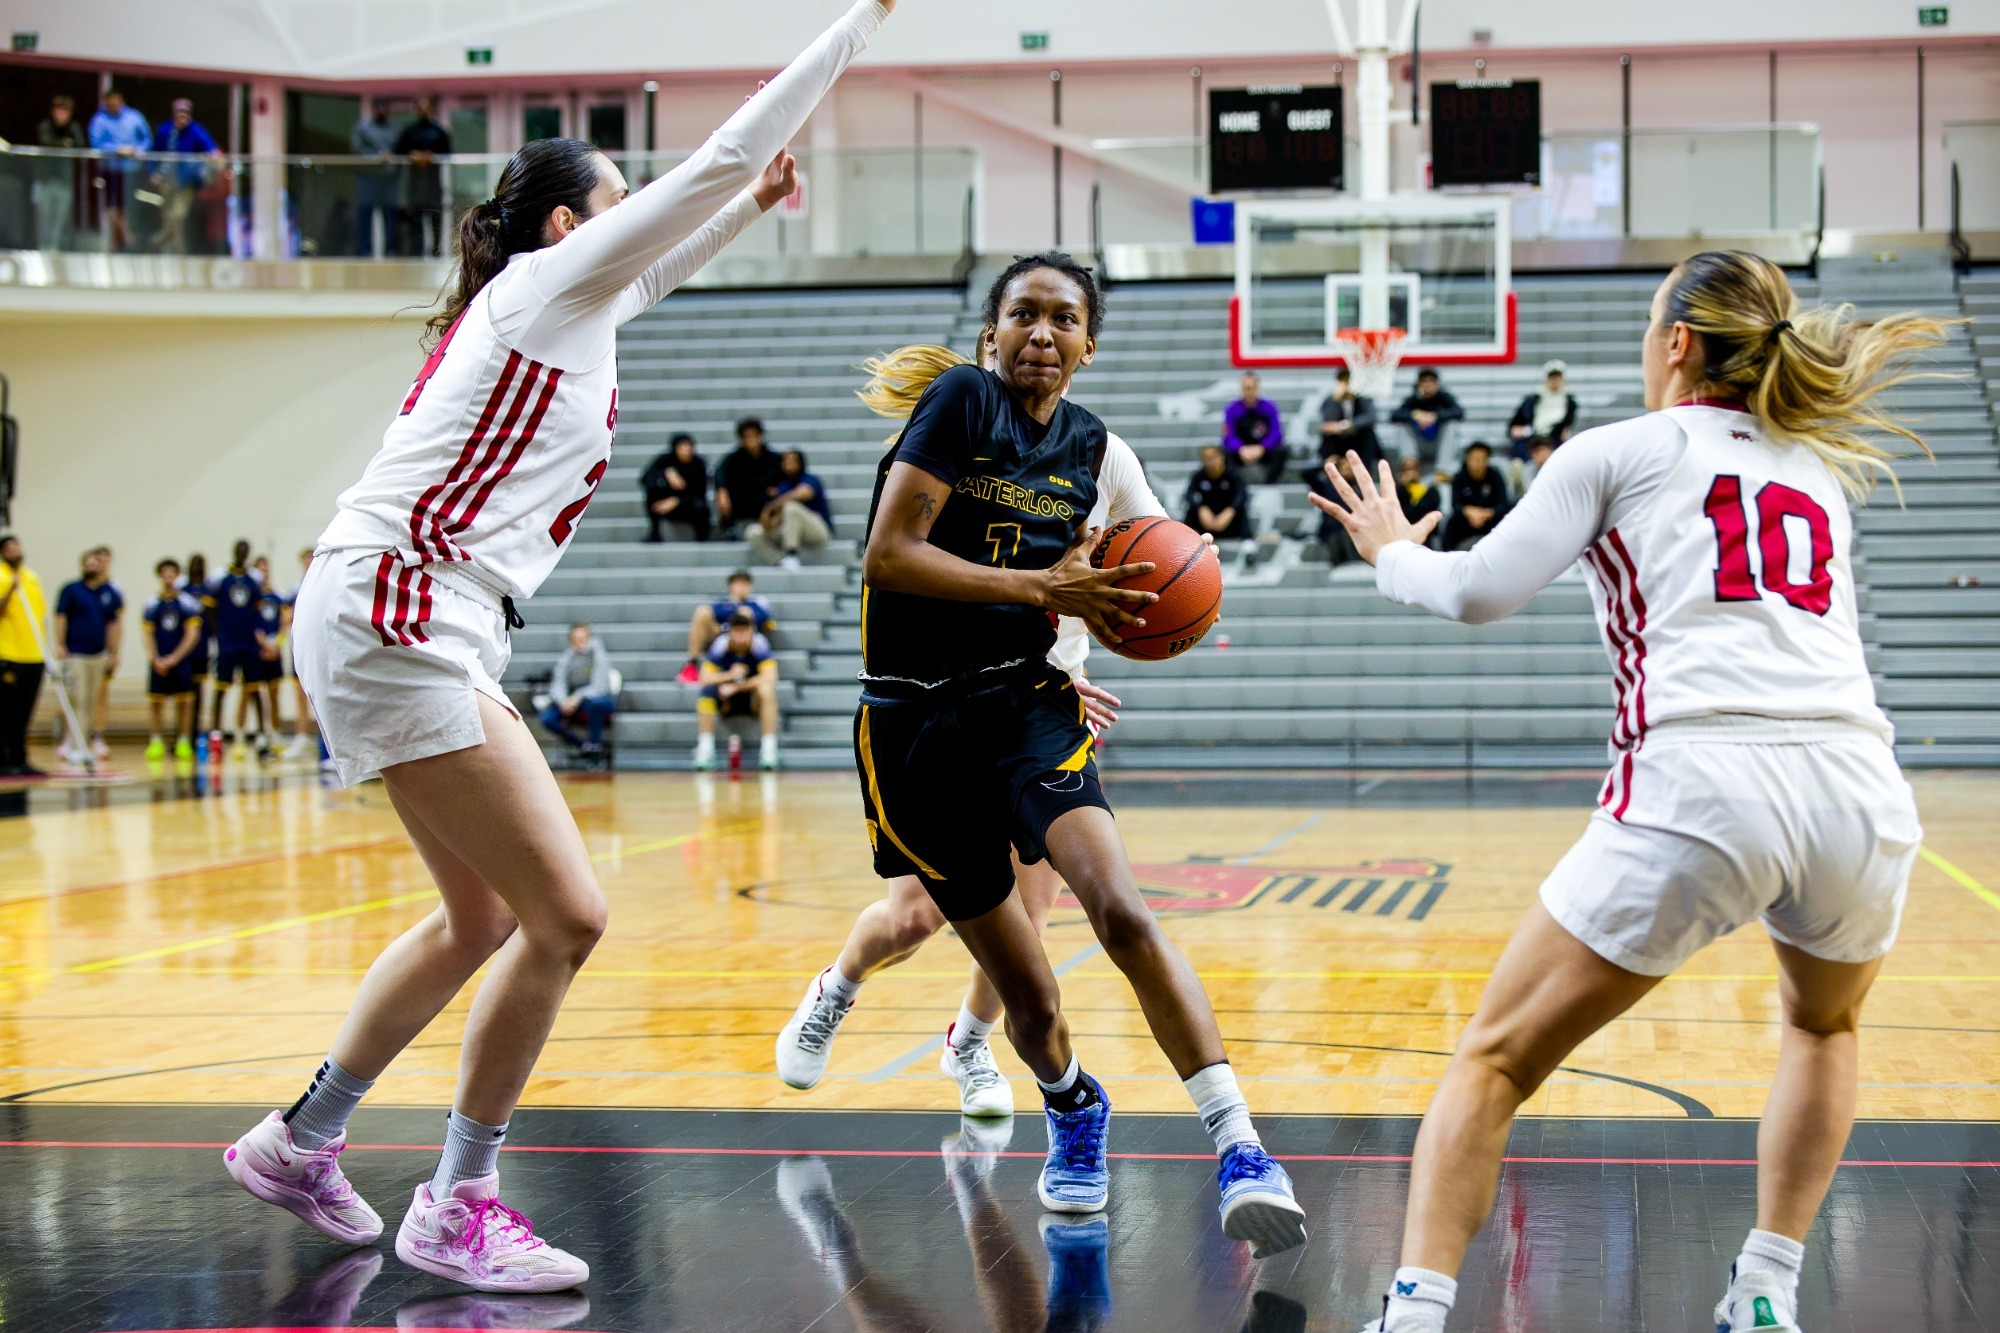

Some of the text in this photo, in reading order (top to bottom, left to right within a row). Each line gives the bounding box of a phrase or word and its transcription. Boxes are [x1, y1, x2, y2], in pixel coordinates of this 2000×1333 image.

[1219, 110, 1260, 132] HOME
[1287, 108, 1333, 131] GUEST
[1048, 475, 1073, 488] OUA
[956, 475, 1074, 521] ATERLOO
[1703, 474, 1834, 618] 10
